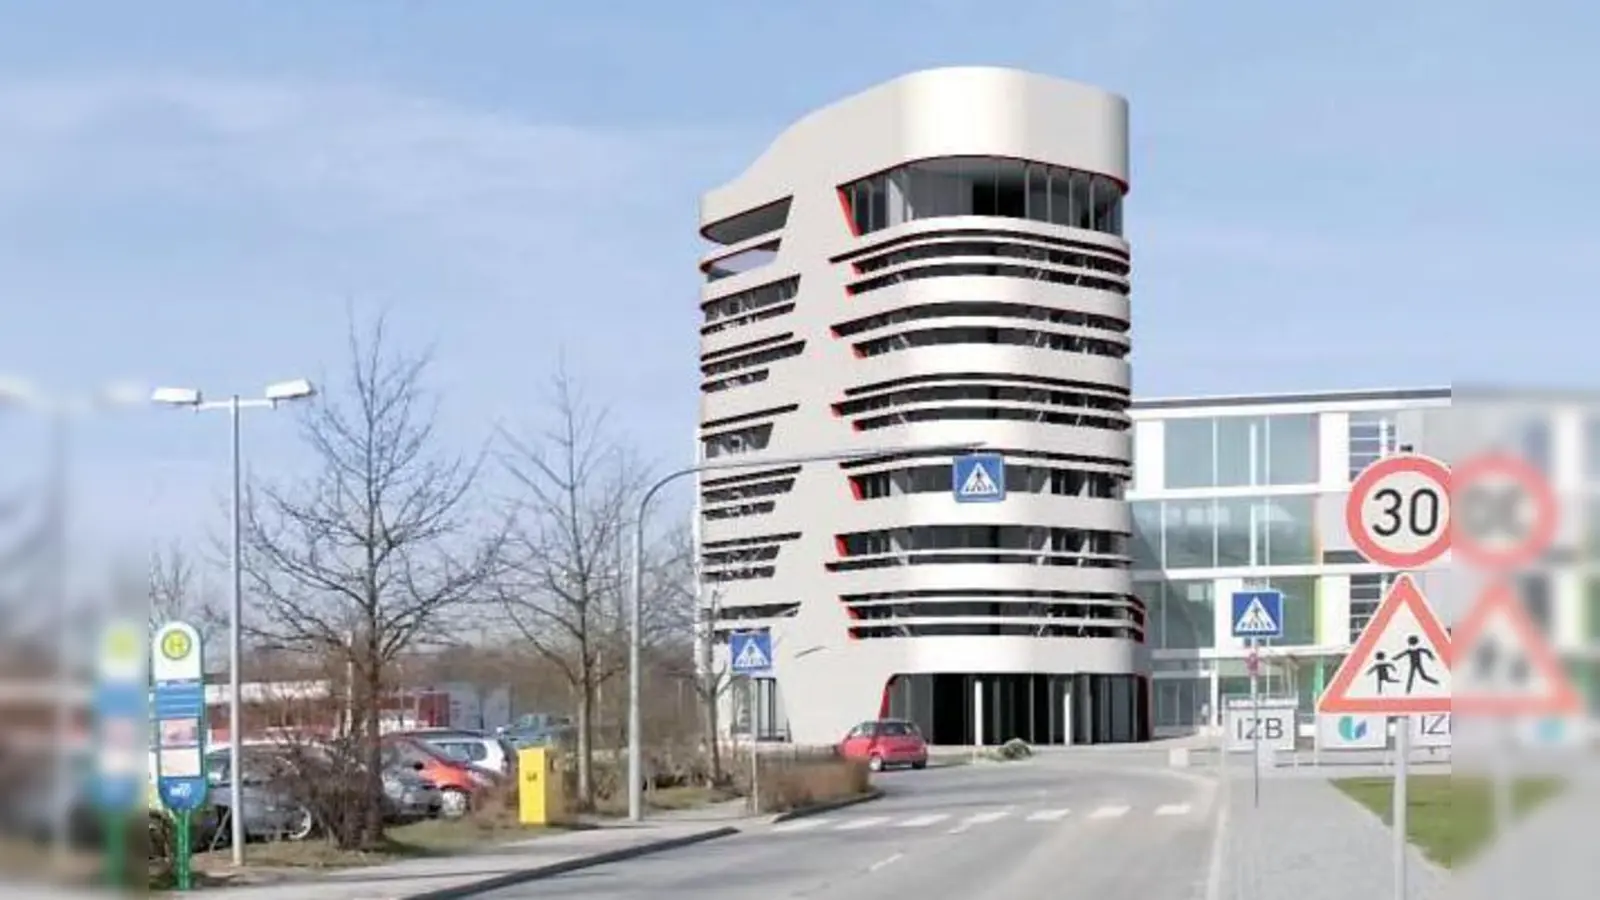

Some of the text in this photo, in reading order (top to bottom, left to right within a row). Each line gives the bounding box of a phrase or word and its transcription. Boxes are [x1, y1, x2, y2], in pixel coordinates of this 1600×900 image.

[1373, 488, 1438, 537] 30
[169, 637, 185, 653] H
[1237, 717, 1283, 740] IZB
[1421, 713, 1451, 735] IZ
